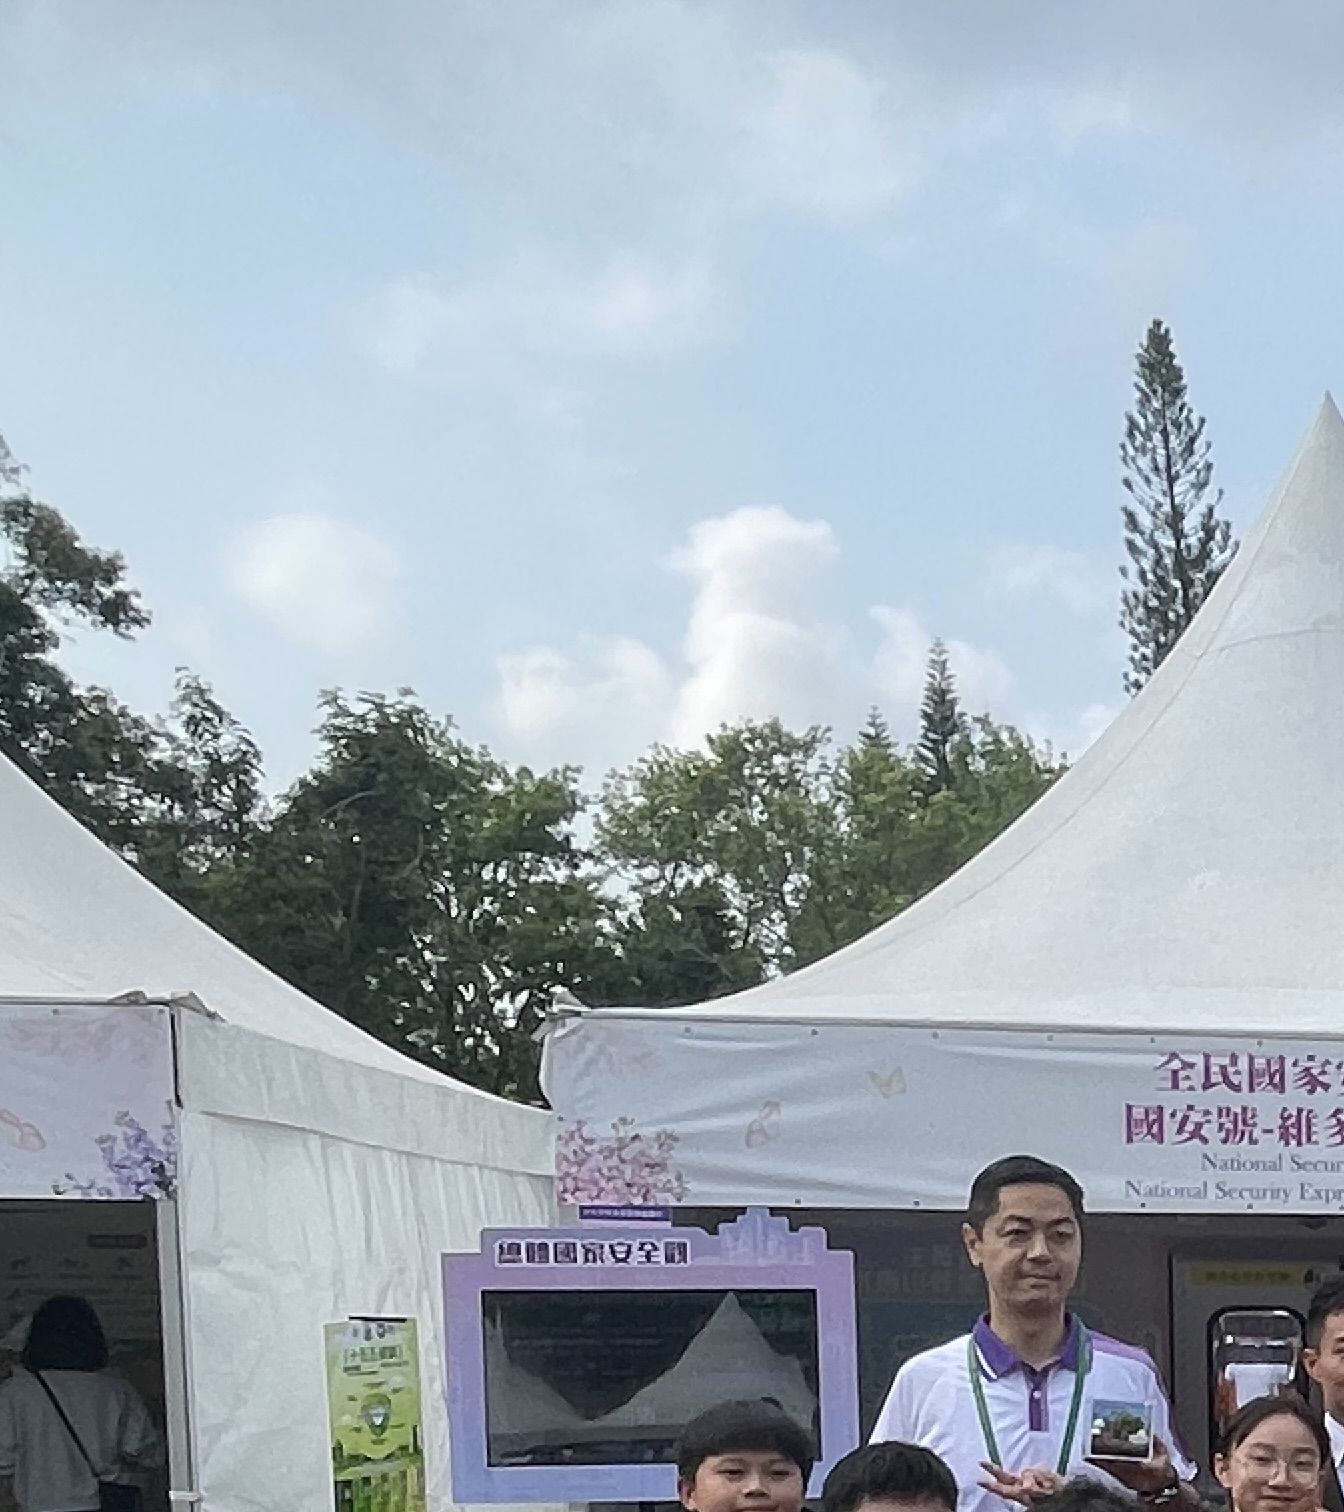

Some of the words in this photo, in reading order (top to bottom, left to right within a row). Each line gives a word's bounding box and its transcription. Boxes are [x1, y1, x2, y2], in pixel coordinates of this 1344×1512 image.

[1201, 1153, 1284, 1173] National
[1125, 1180, 1208, 1200] National
[1215, 1181, 1292, 1203] Security
